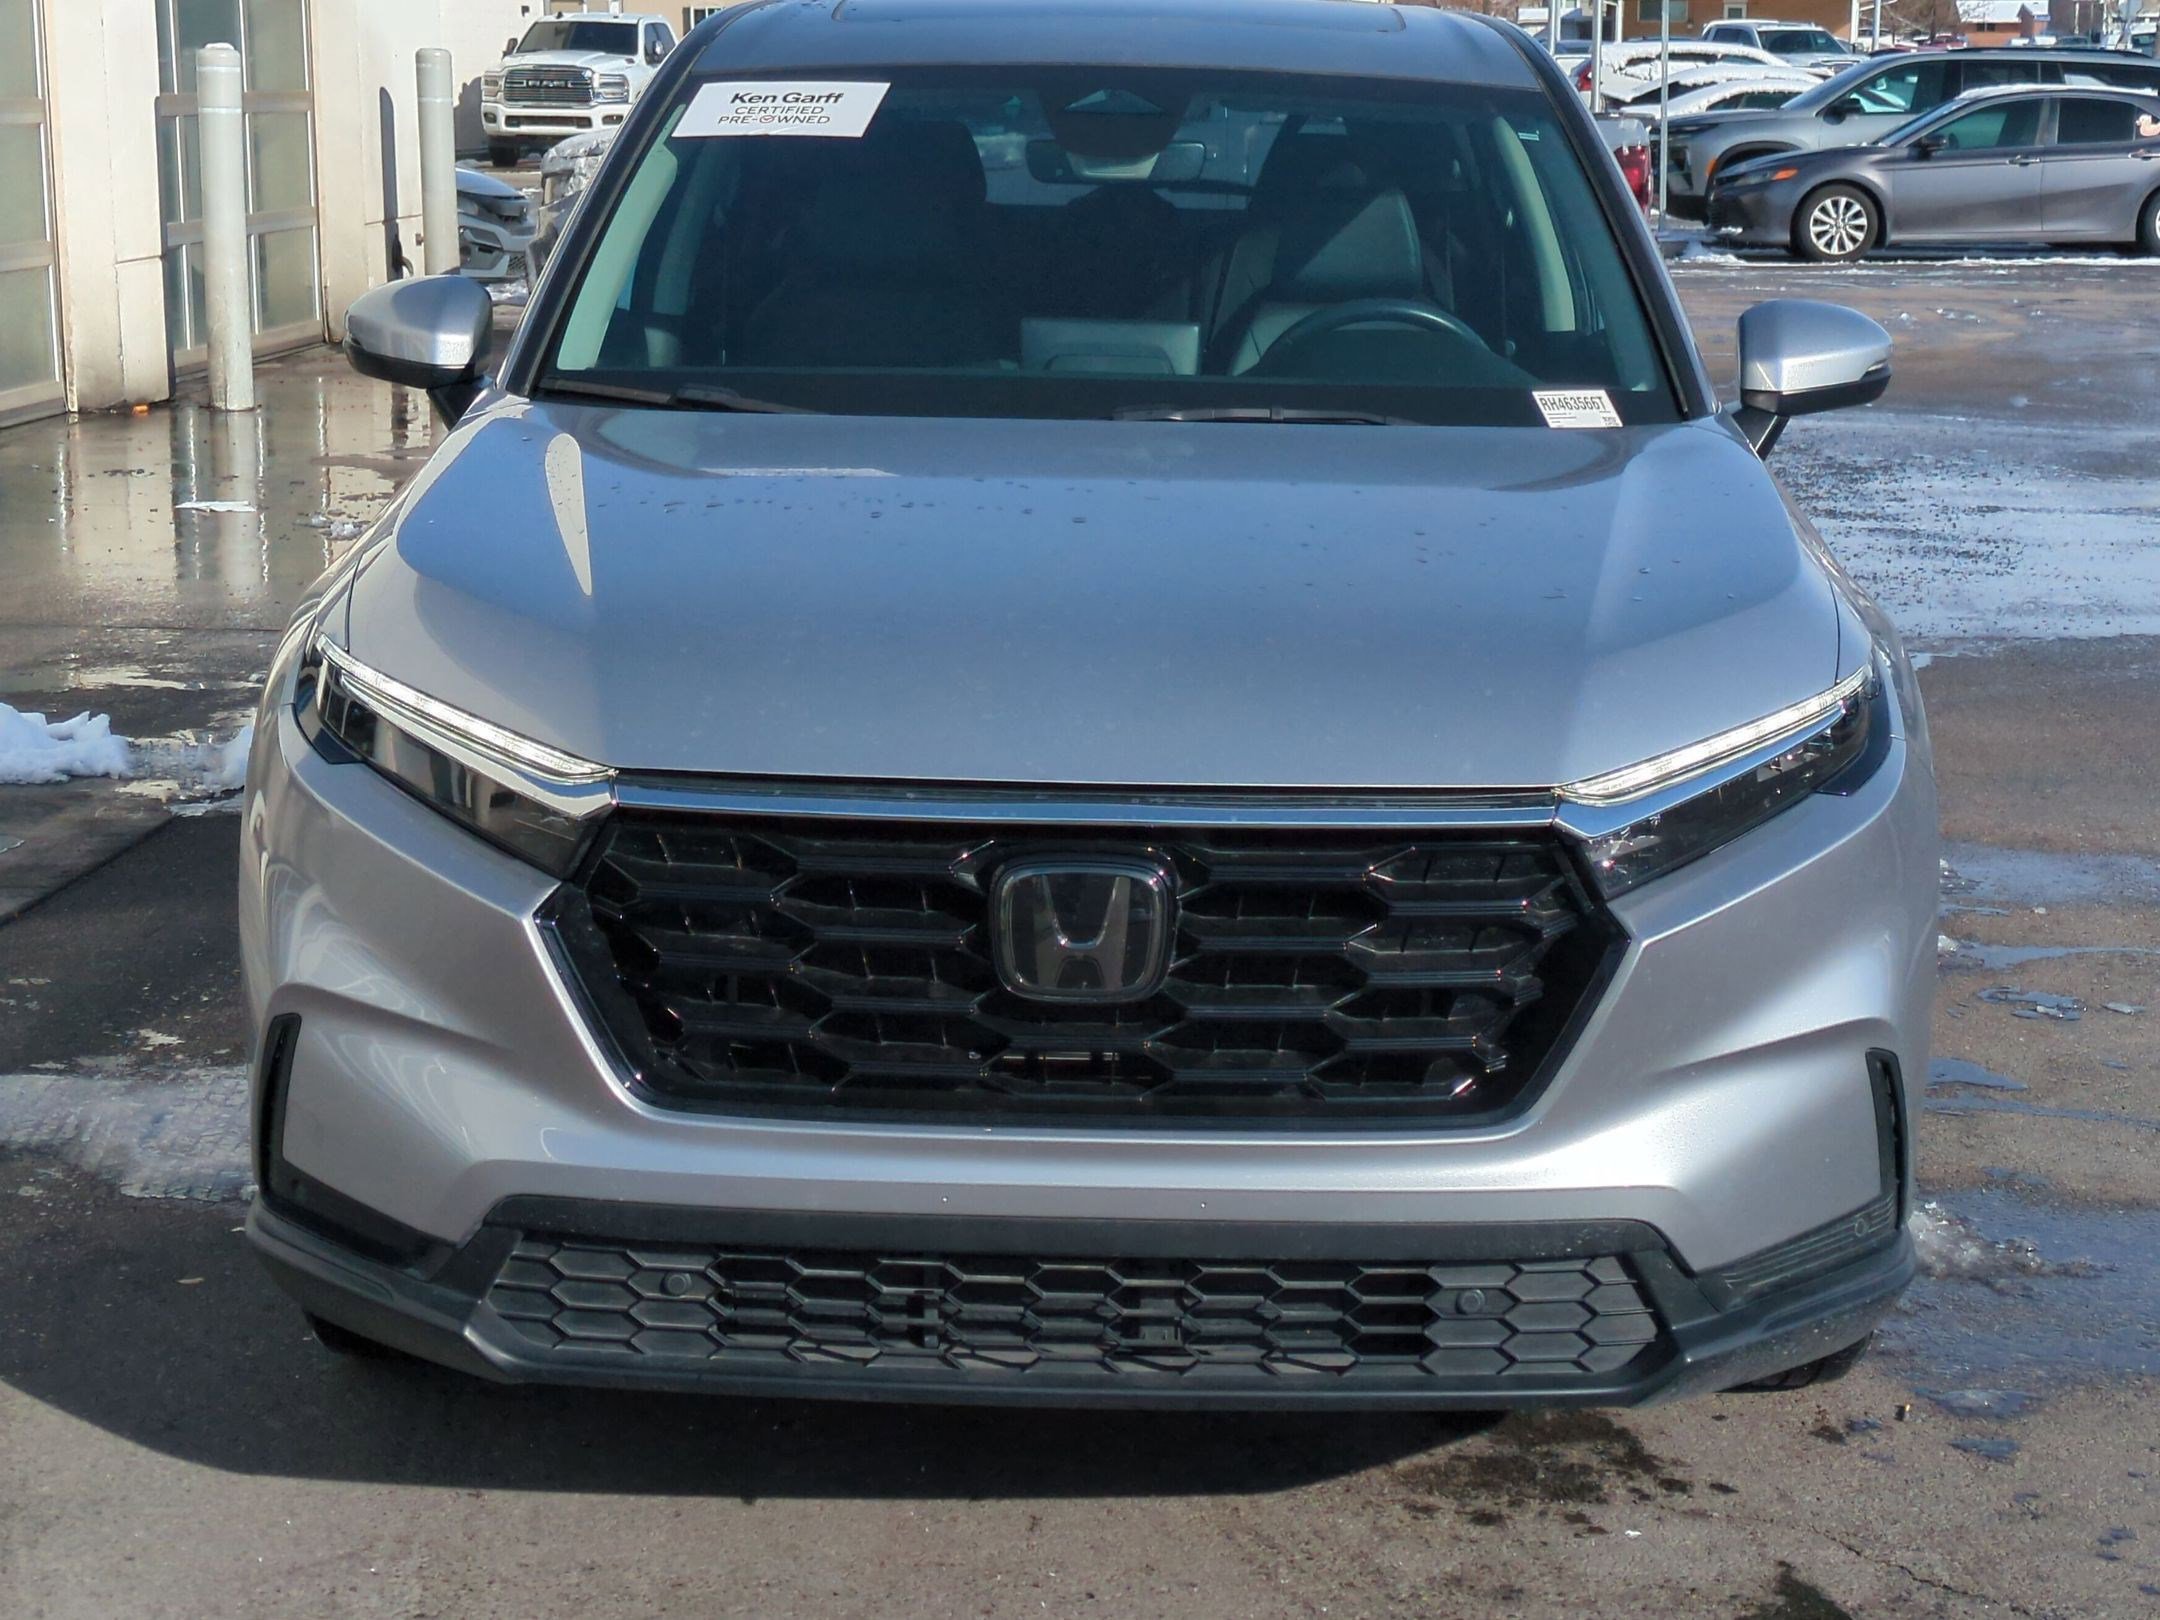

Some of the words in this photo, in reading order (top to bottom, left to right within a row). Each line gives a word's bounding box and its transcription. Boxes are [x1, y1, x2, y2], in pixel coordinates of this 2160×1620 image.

[730, 92, 775, 104] Ken
[782, 92, 844, 104] Garff
[734, 106, 825, 115] CERTIFIED
[718, 115, 831, 124] PRE-OWNED
